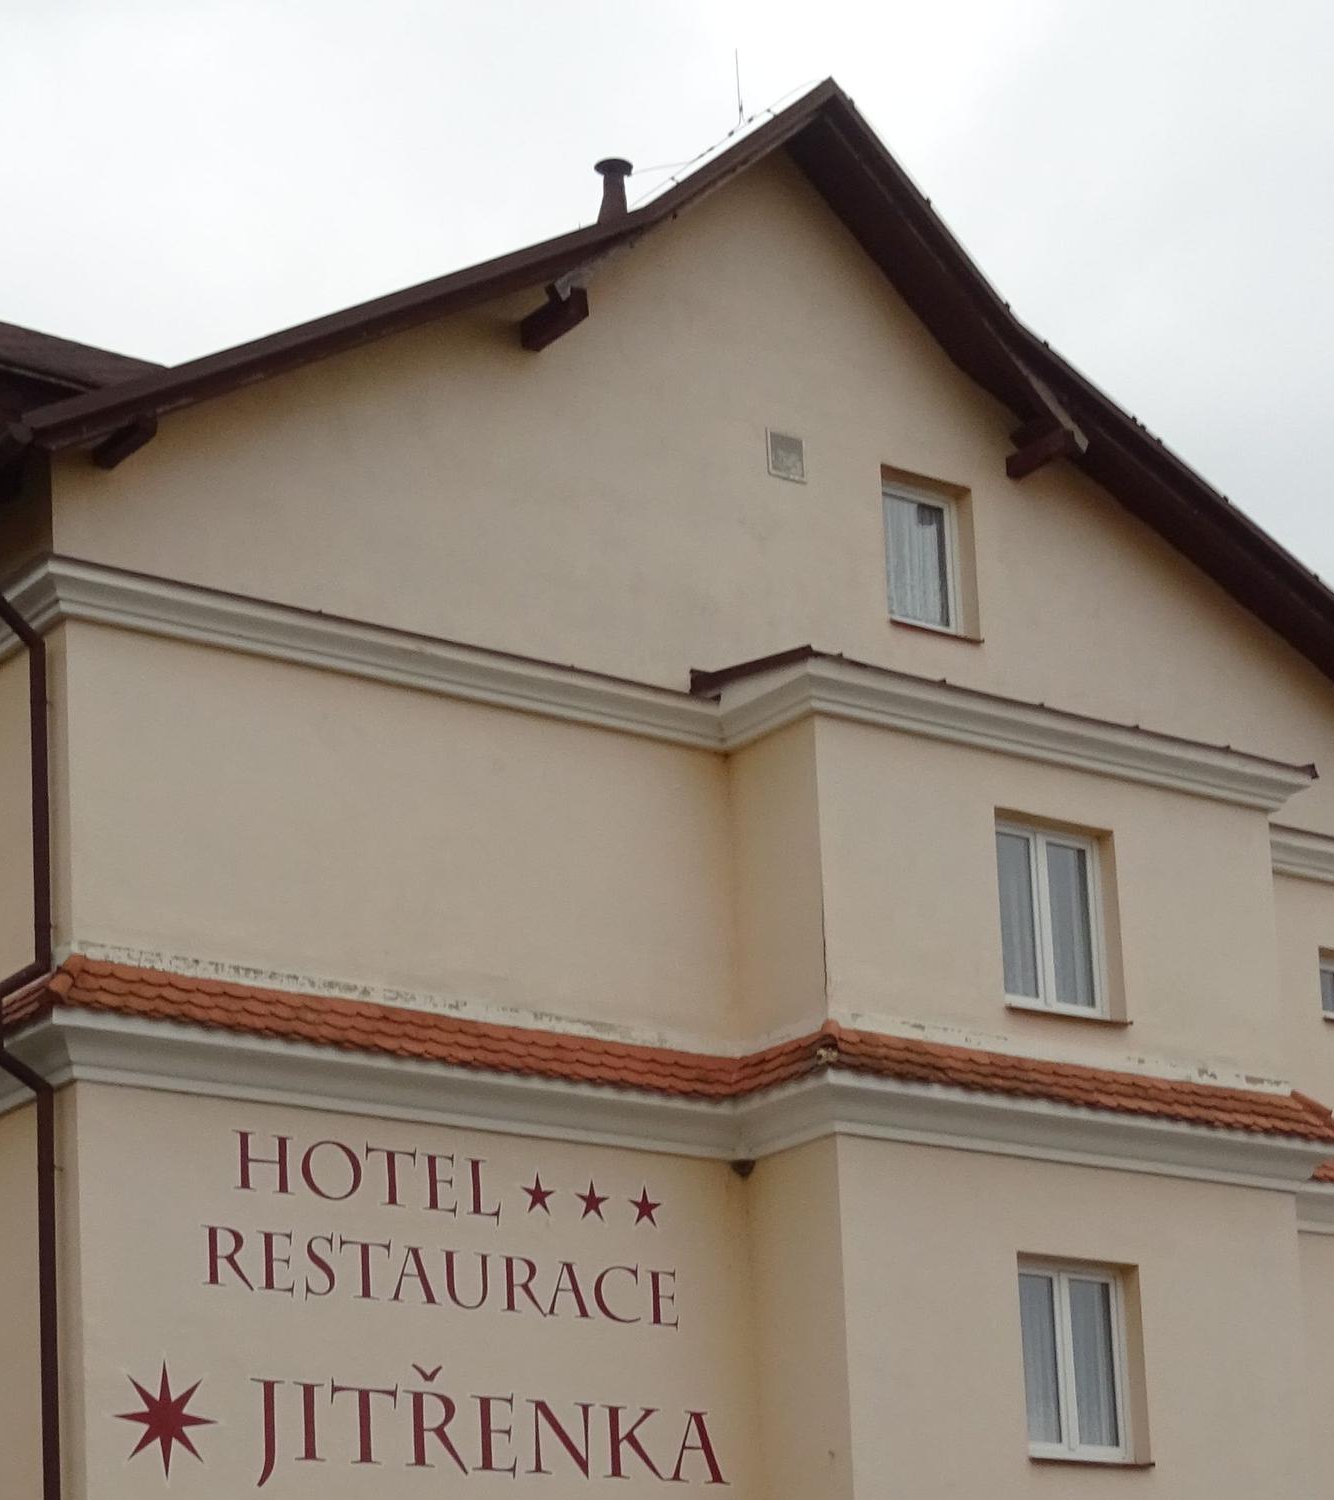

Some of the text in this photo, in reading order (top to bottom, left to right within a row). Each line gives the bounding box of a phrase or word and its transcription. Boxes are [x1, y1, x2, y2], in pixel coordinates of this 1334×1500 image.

[232, 1129, 501, 1226] HOTEL
[201, 1224, 680, 1330] RESTAURACE
[250, 1364, 731, 1488] JITŘENKA
